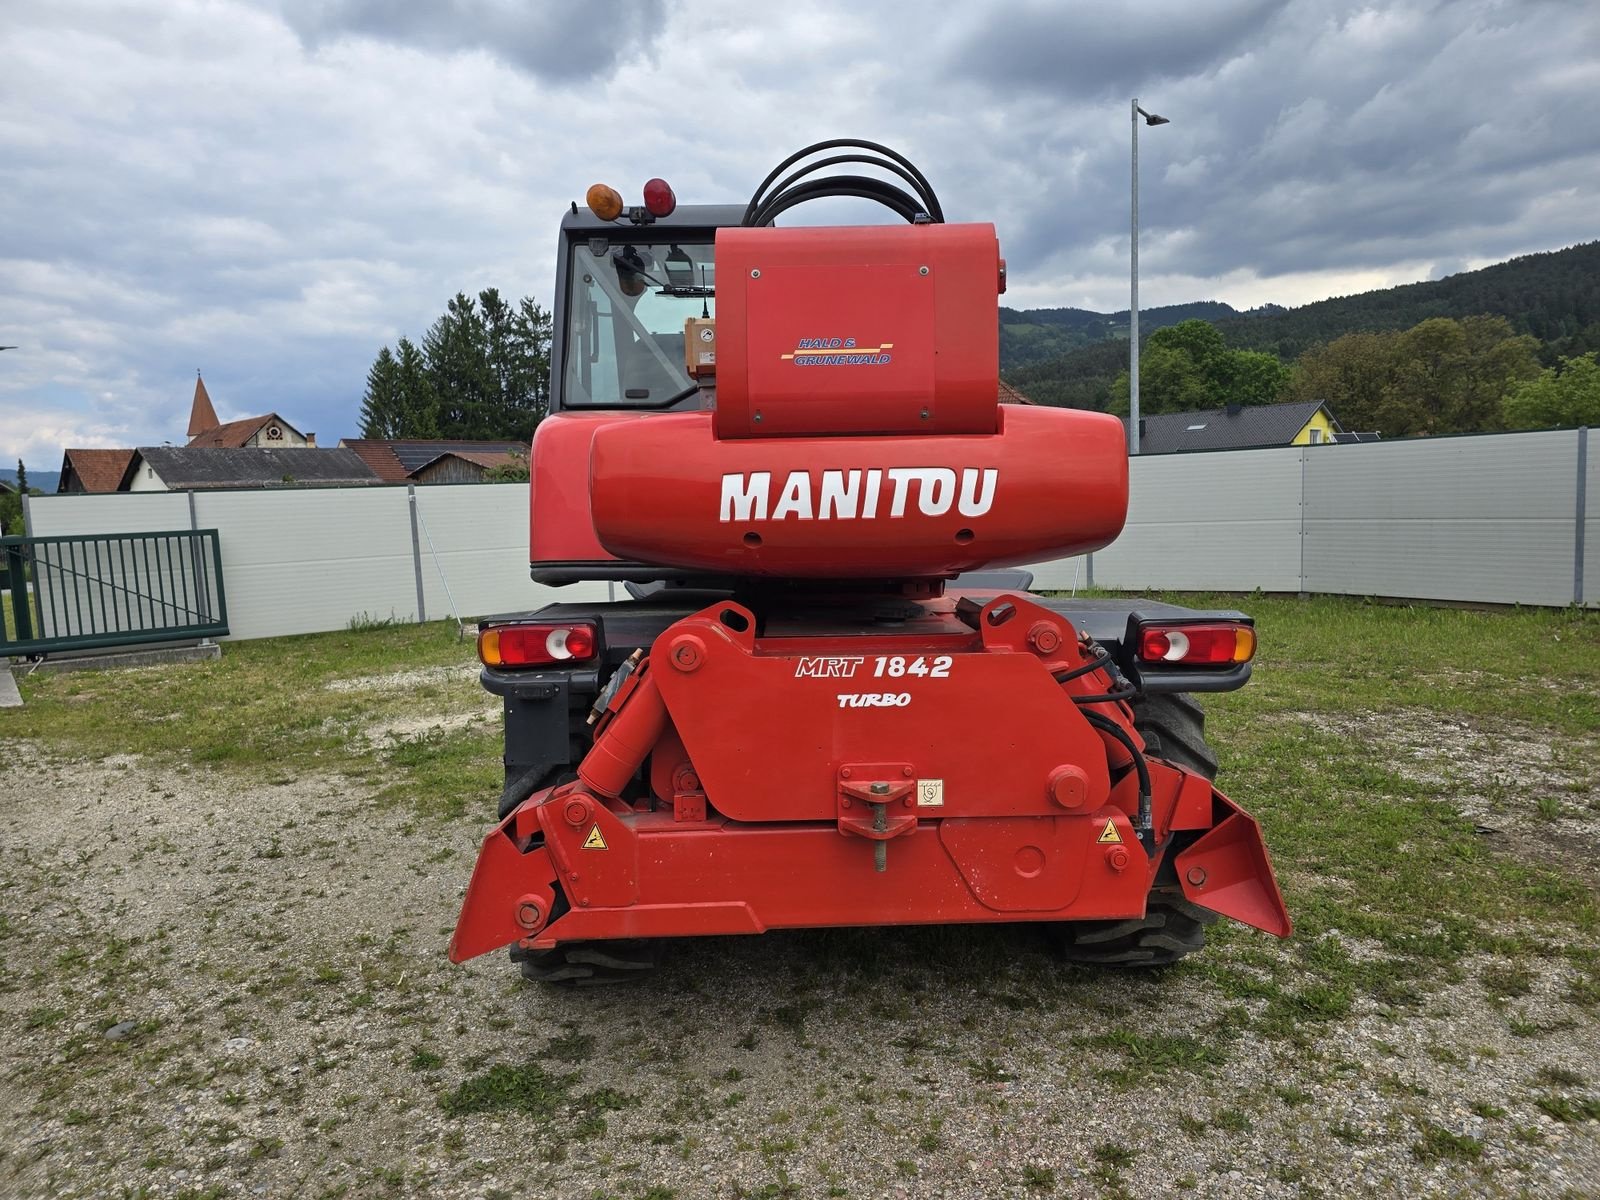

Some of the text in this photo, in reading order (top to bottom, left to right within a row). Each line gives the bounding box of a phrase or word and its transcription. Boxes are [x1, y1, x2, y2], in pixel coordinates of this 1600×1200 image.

[798, 338, 856, 349] HALD &
[794, 354, 891, 366] GRUNEWALD
[719, 467, 999, 523] MANITOU
[794, 655, 953, 678] MRT 1842
[837, 692, 912, 708] TURBO
